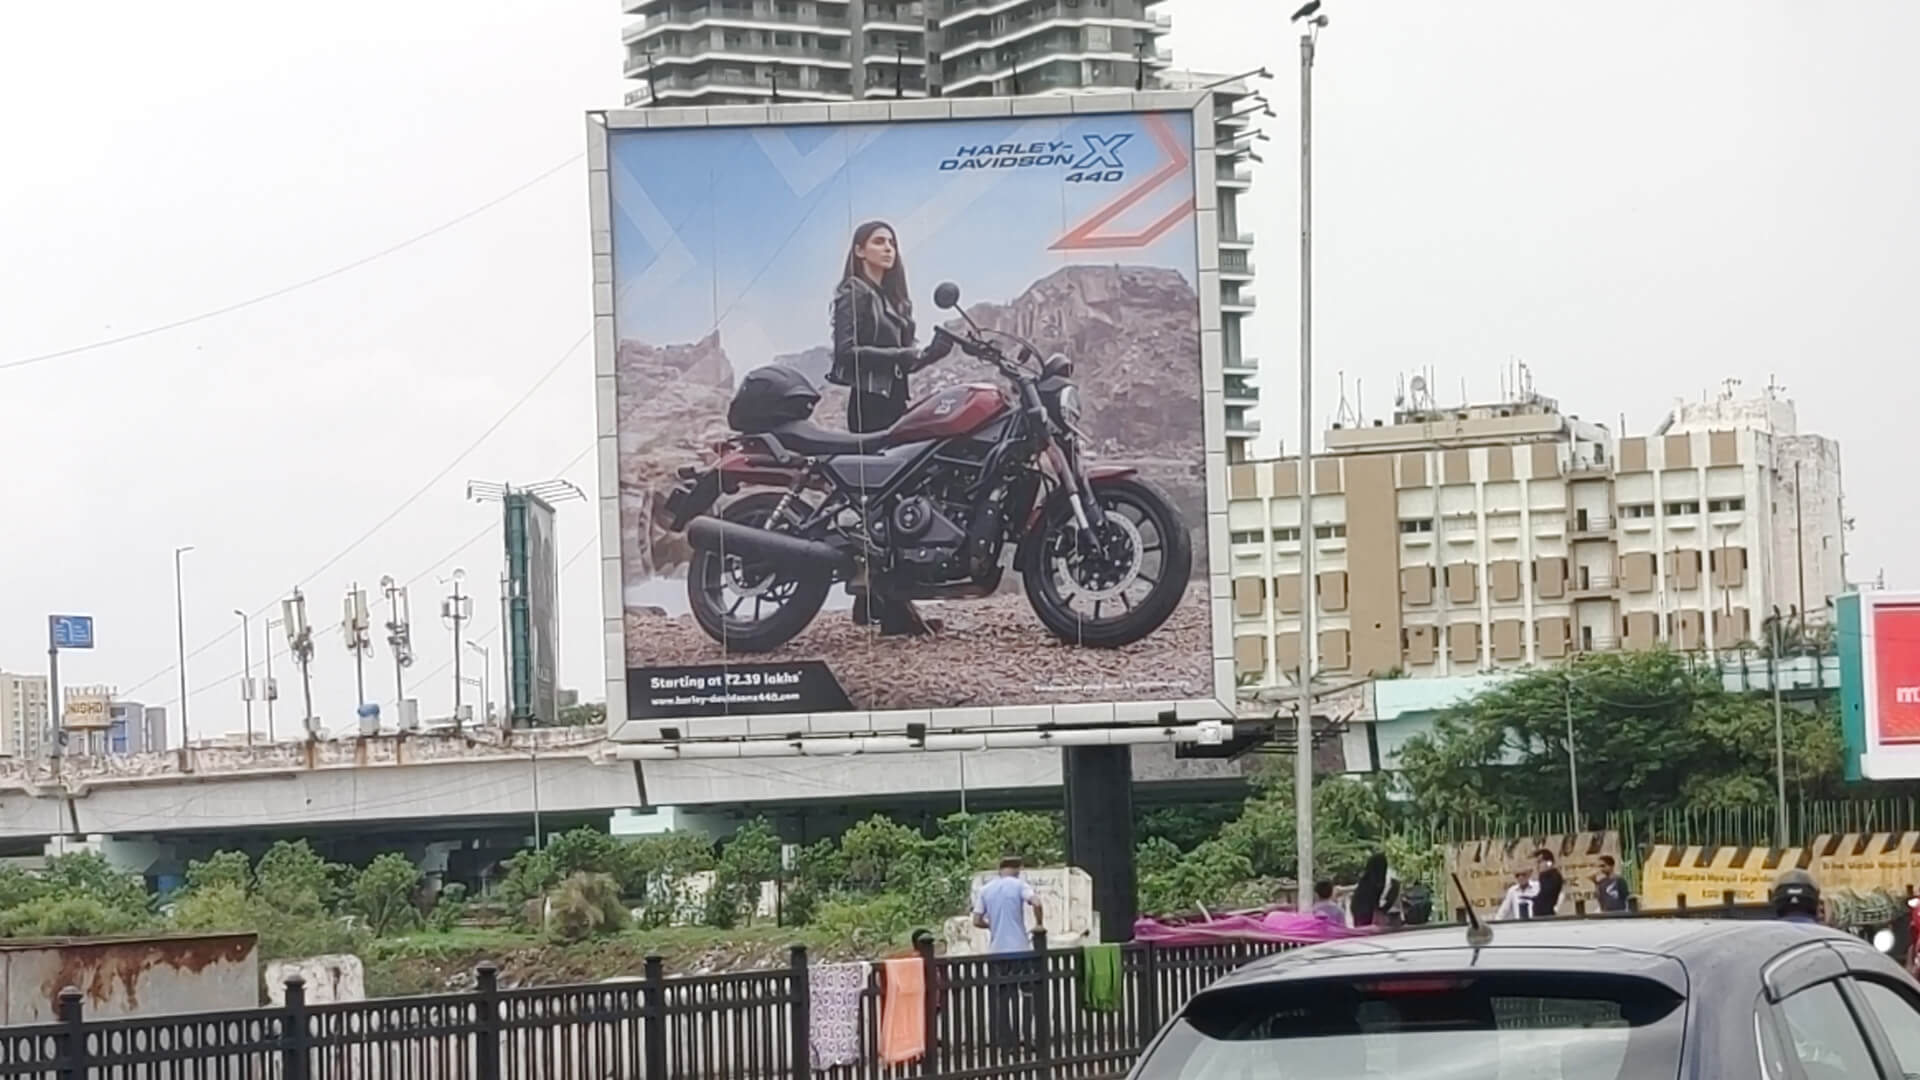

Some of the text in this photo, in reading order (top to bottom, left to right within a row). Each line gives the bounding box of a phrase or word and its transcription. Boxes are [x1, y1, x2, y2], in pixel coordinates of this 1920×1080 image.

[956, 141, 1073, 156] HARLEY-
[1071, 134, 1134, 169] X
[939, 154, 1075, 171] DAVIDSON
[1065, 170, 1123, 183] 440
[650, 675, 705, 690] Starting
[707, 675, 722, 687] at
